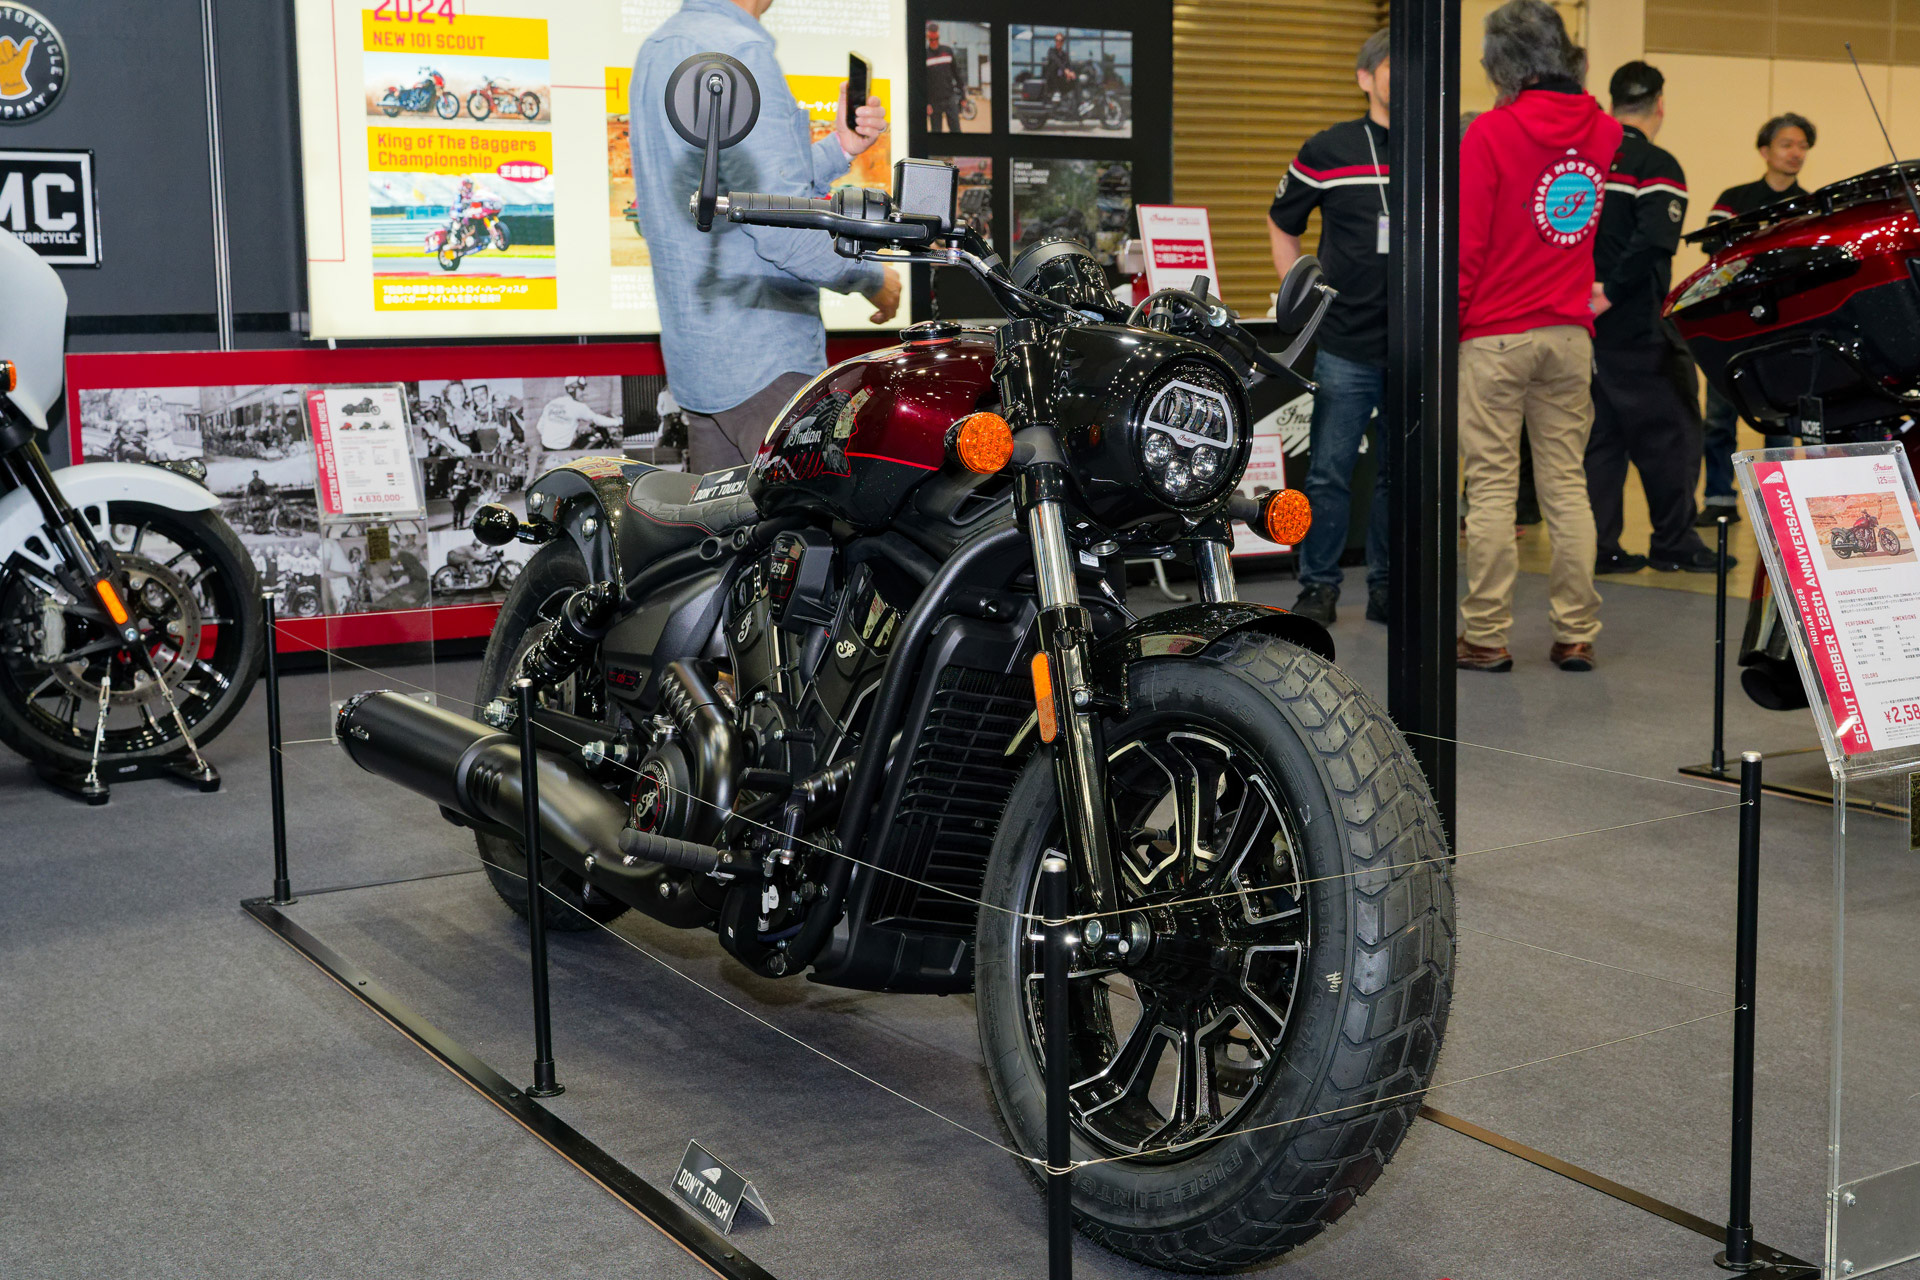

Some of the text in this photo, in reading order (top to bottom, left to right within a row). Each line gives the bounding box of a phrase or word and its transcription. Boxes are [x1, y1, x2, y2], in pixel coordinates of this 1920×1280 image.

[374, 0, 456, 25] 2024
[0, 7, 63, 77] TORCYCLE
[373, 31, 486, 50] NEW 101 SCOUT
[377, 133, 537, 153] King of The Baggers
[378, 151, 493, 169] Championship
[1534, 173, 1554, 231] INDIAN
[1553, 233, 1582, 245] 1901
[789, 422, 822, 446] Indian
[694, 480, 746, 501] DON'T TOUCH
[1776, 489, 1819, 588] ANNIVERSARY
[1811, 590, 1832, 631] 125th
[1805, 615, 1820, 646] INDIAN
[1823, 634, 1852, 693] BOBBER
[1139, 1149, 1243, 1209] PIRELLI
[677, 1168, 732, 1222] DON'T TOUCH
